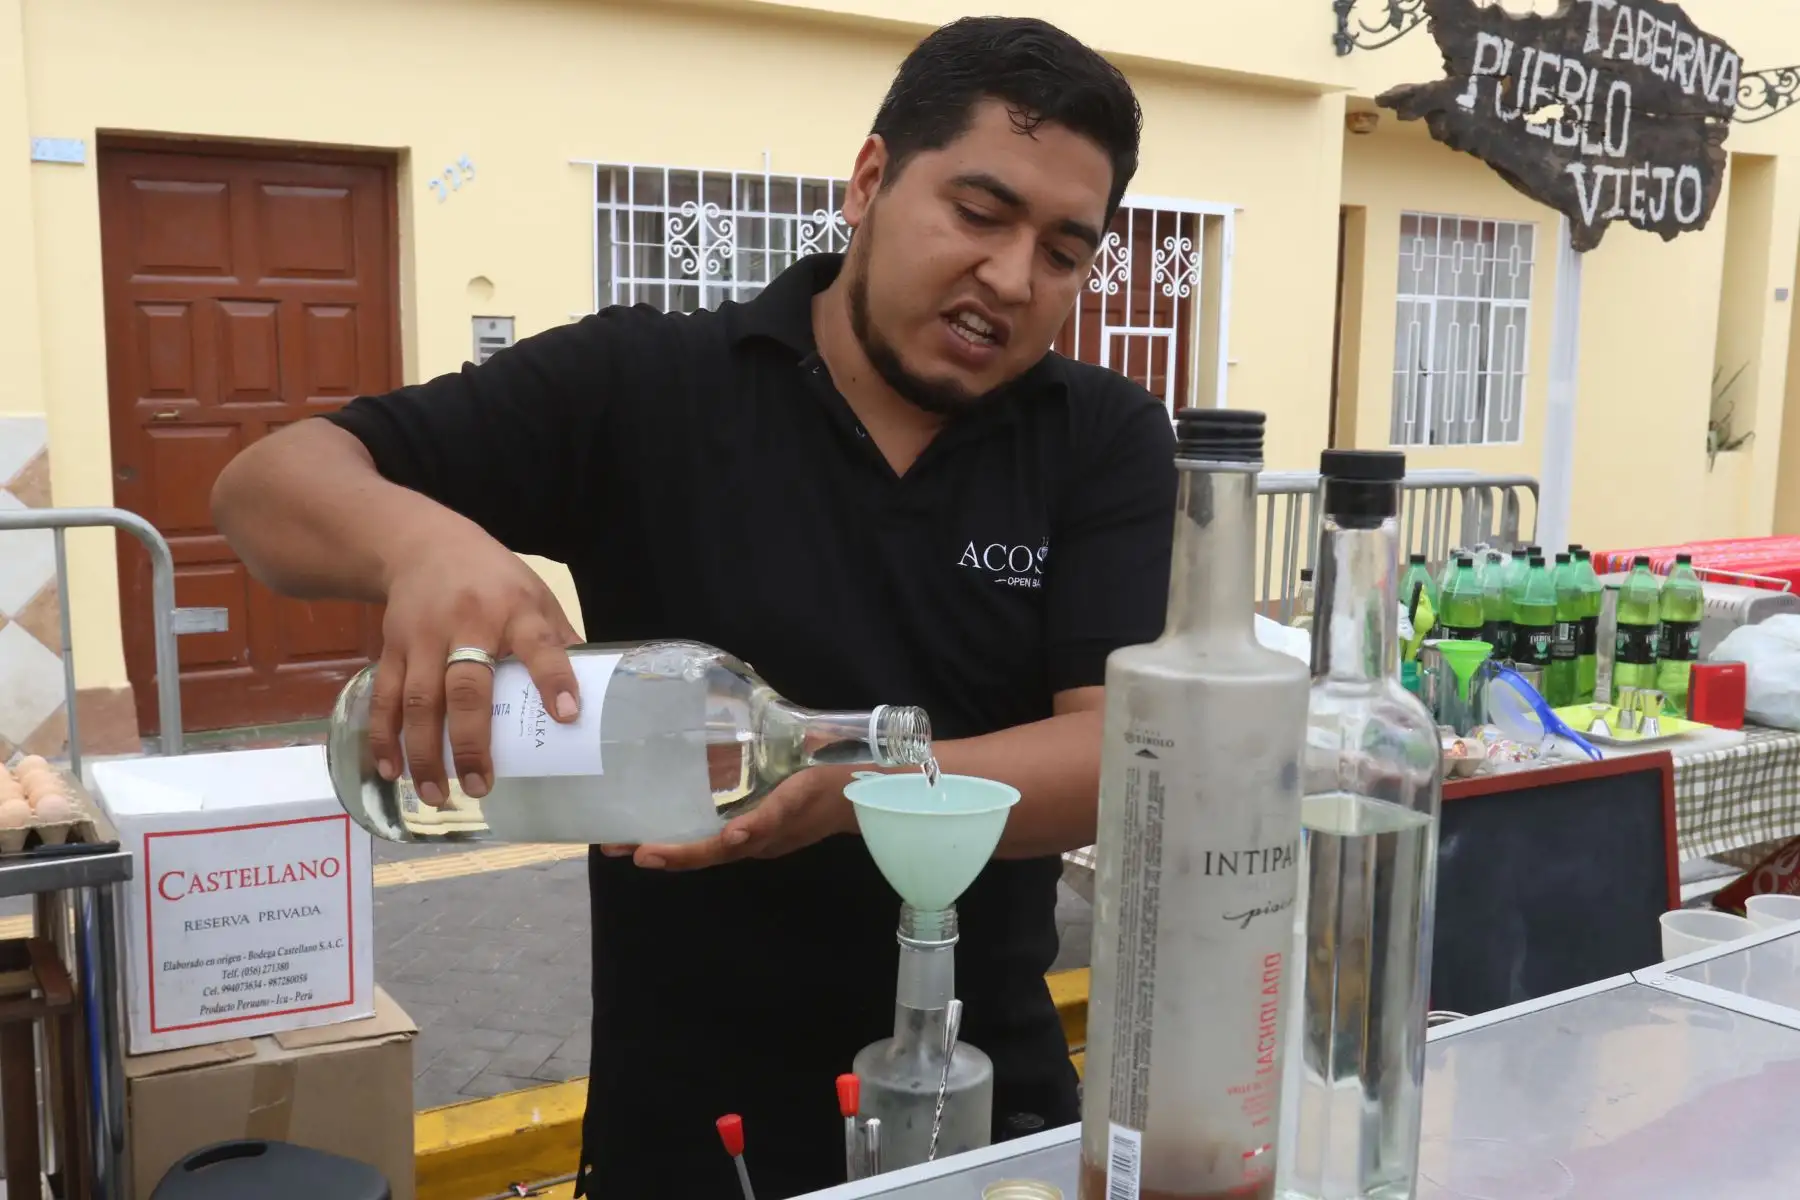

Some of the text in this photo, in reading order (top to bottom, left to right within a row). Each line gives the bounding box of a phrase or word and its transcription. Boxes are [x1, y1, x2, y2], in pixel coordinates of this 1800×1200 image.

[1578, 0, 1740, 107] TABERNA
[1456, 31, 1632, 157] PUEBLO
[1565, 161, 1703, 227] VIEJO
[1007, 576, 1031, 588] OPEN
[535, 699, 547, 749] ALKA
[157, 856, 340, 901] CASTELLANO
[1203, 842, 1297, 877] INTIPA
[184, 905, 322, 932] RESERVA PRIVADA
[162, 958, 204, 972] Elaborado
[205, 958, 215, 967] en
[216, 953, 242, 967] origen
[248, 949, 276, 961] Bodega
[277, 943, 318, 957] Castellano
[319, 938, 344, 951] S.A.C.
[200, 1002, 235, 1016] Producto
